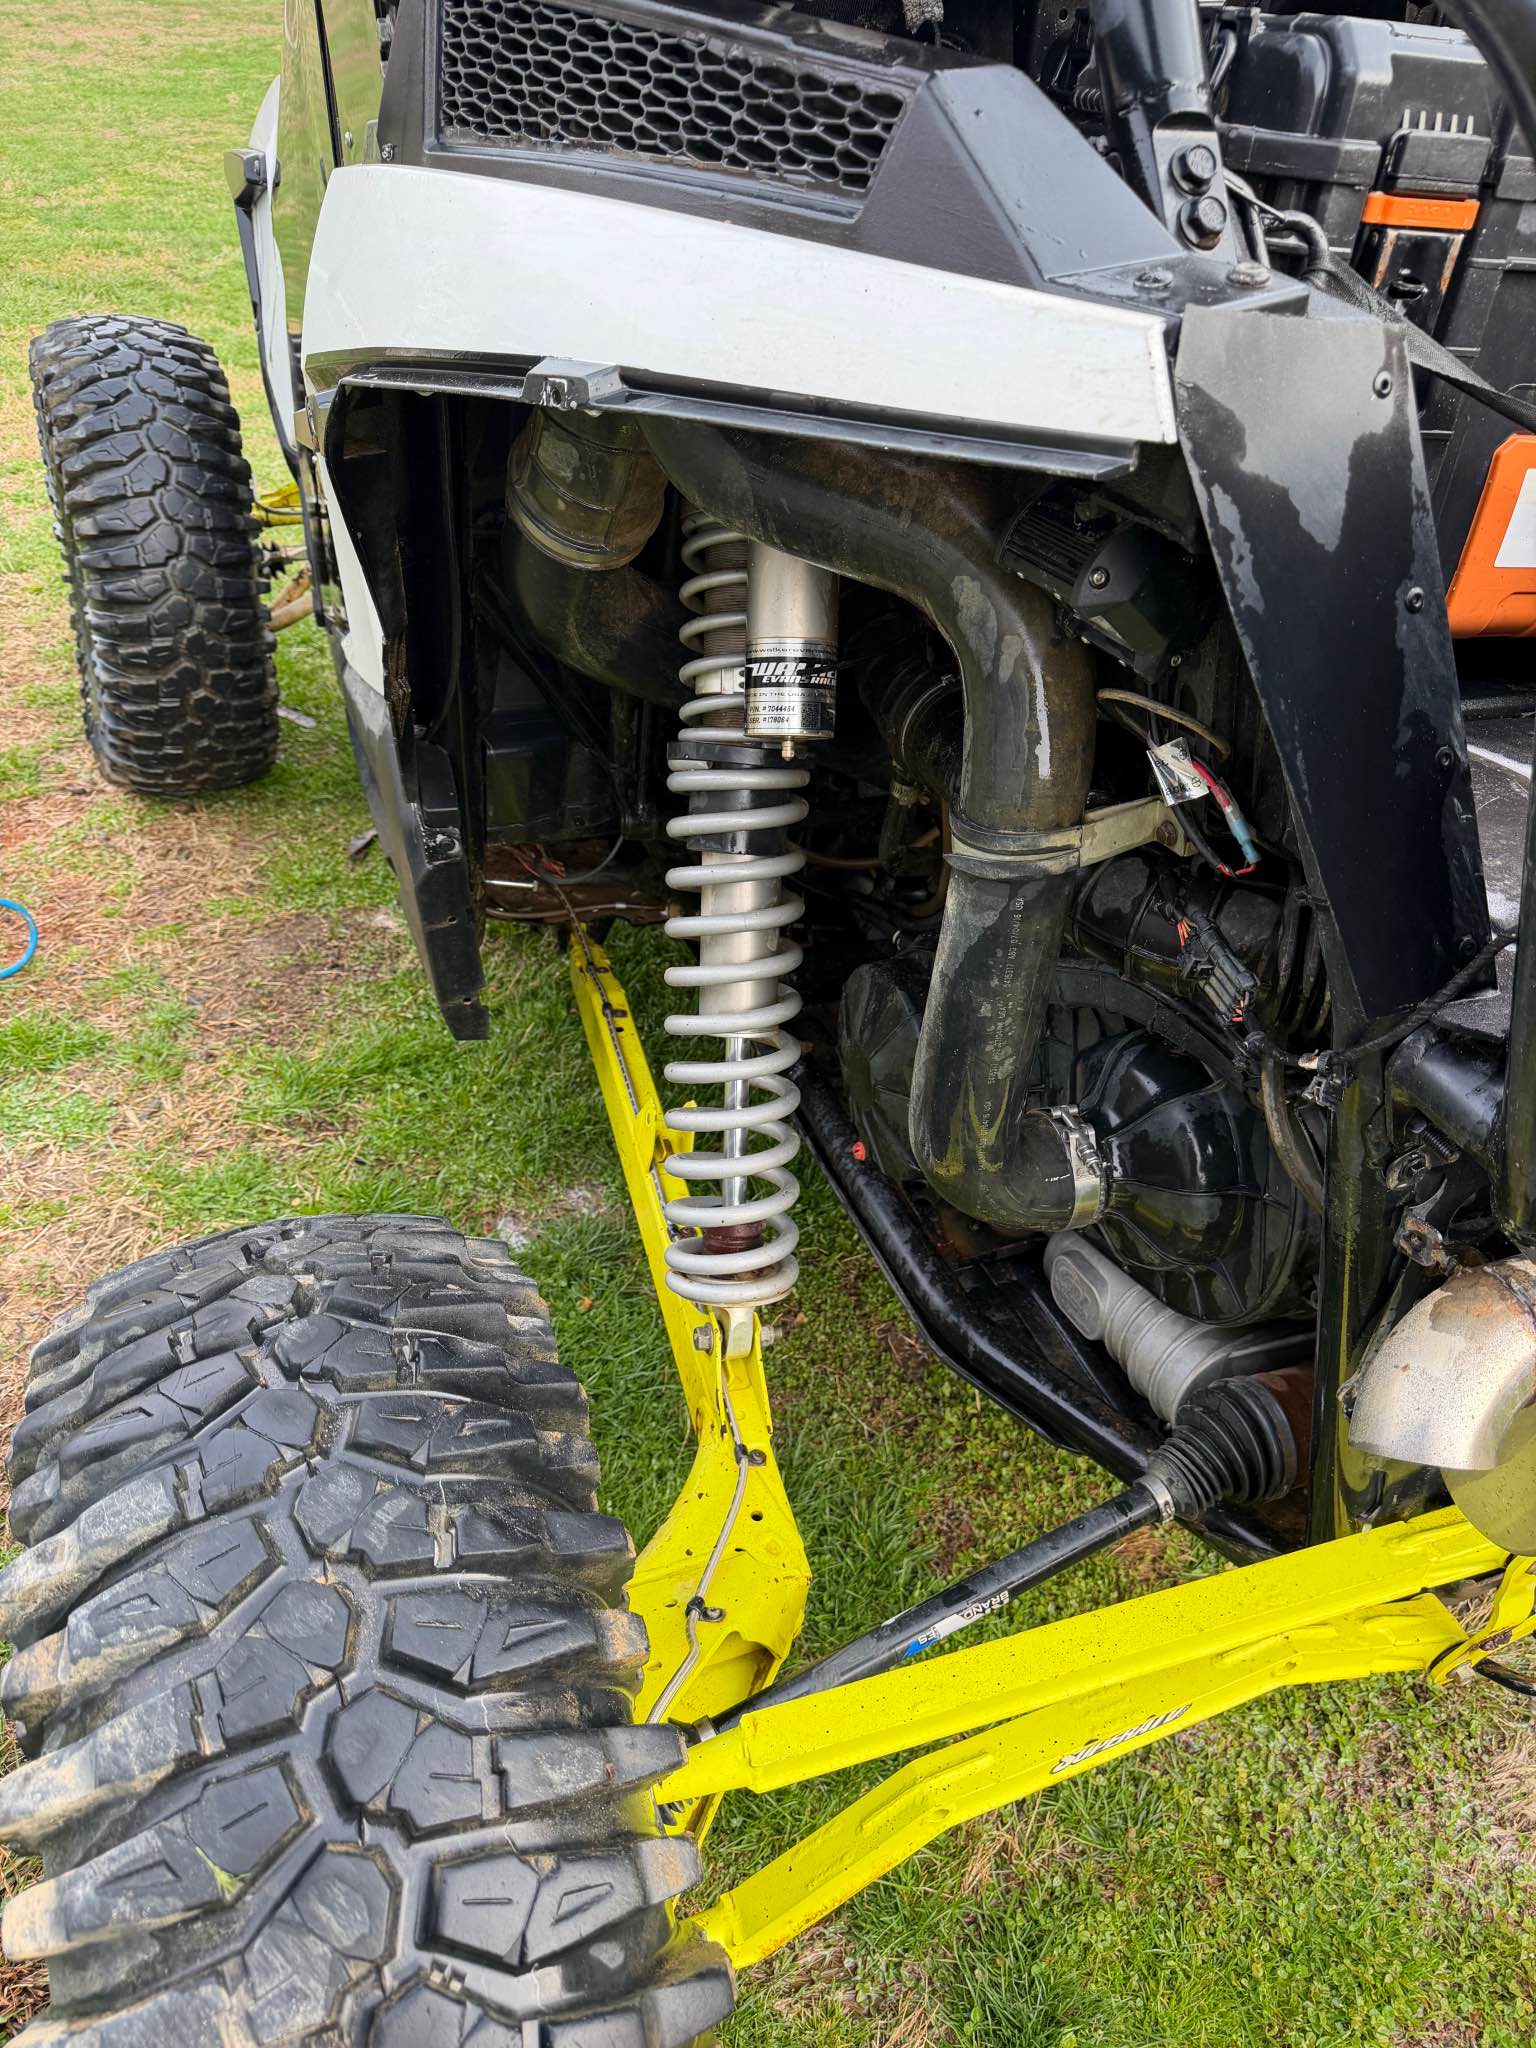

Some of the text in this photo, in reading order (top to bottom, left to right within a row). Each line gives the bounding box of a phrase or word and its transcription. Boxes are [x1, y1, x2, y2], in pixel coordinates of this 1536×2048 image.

[762, 675, 808, 685] EVANS
[1016, 897, 1024, 911] USA
[963, 1590, 1010, 1620] BRAND
